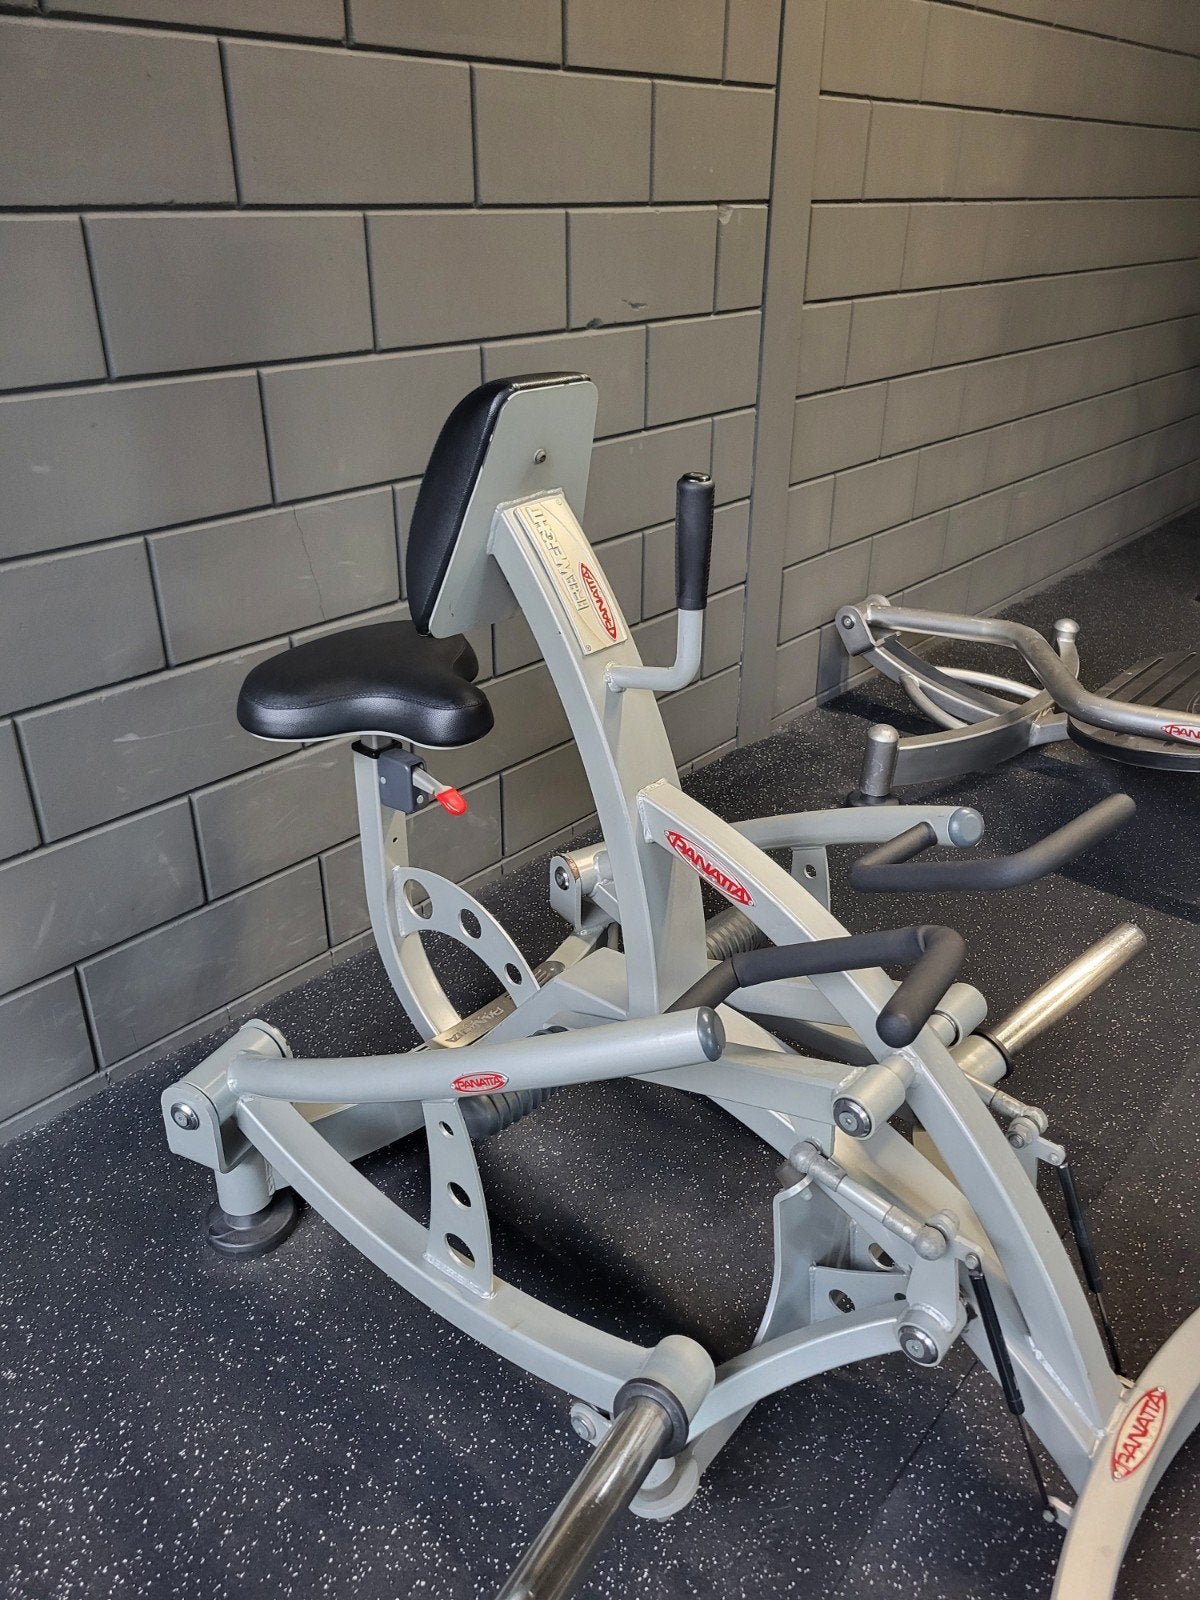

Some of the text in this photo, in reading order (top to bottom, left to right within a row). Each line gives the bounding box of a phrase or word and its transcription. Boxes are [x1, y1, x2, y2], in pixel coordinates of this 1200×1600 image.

[580, 562, 617, 640] PANATTA
[668, 832, 750, 905] PANATTA
[455, 1073, 505, 1091] PANATTA
[1114, 1390, 1165, 1476] PANATTA
